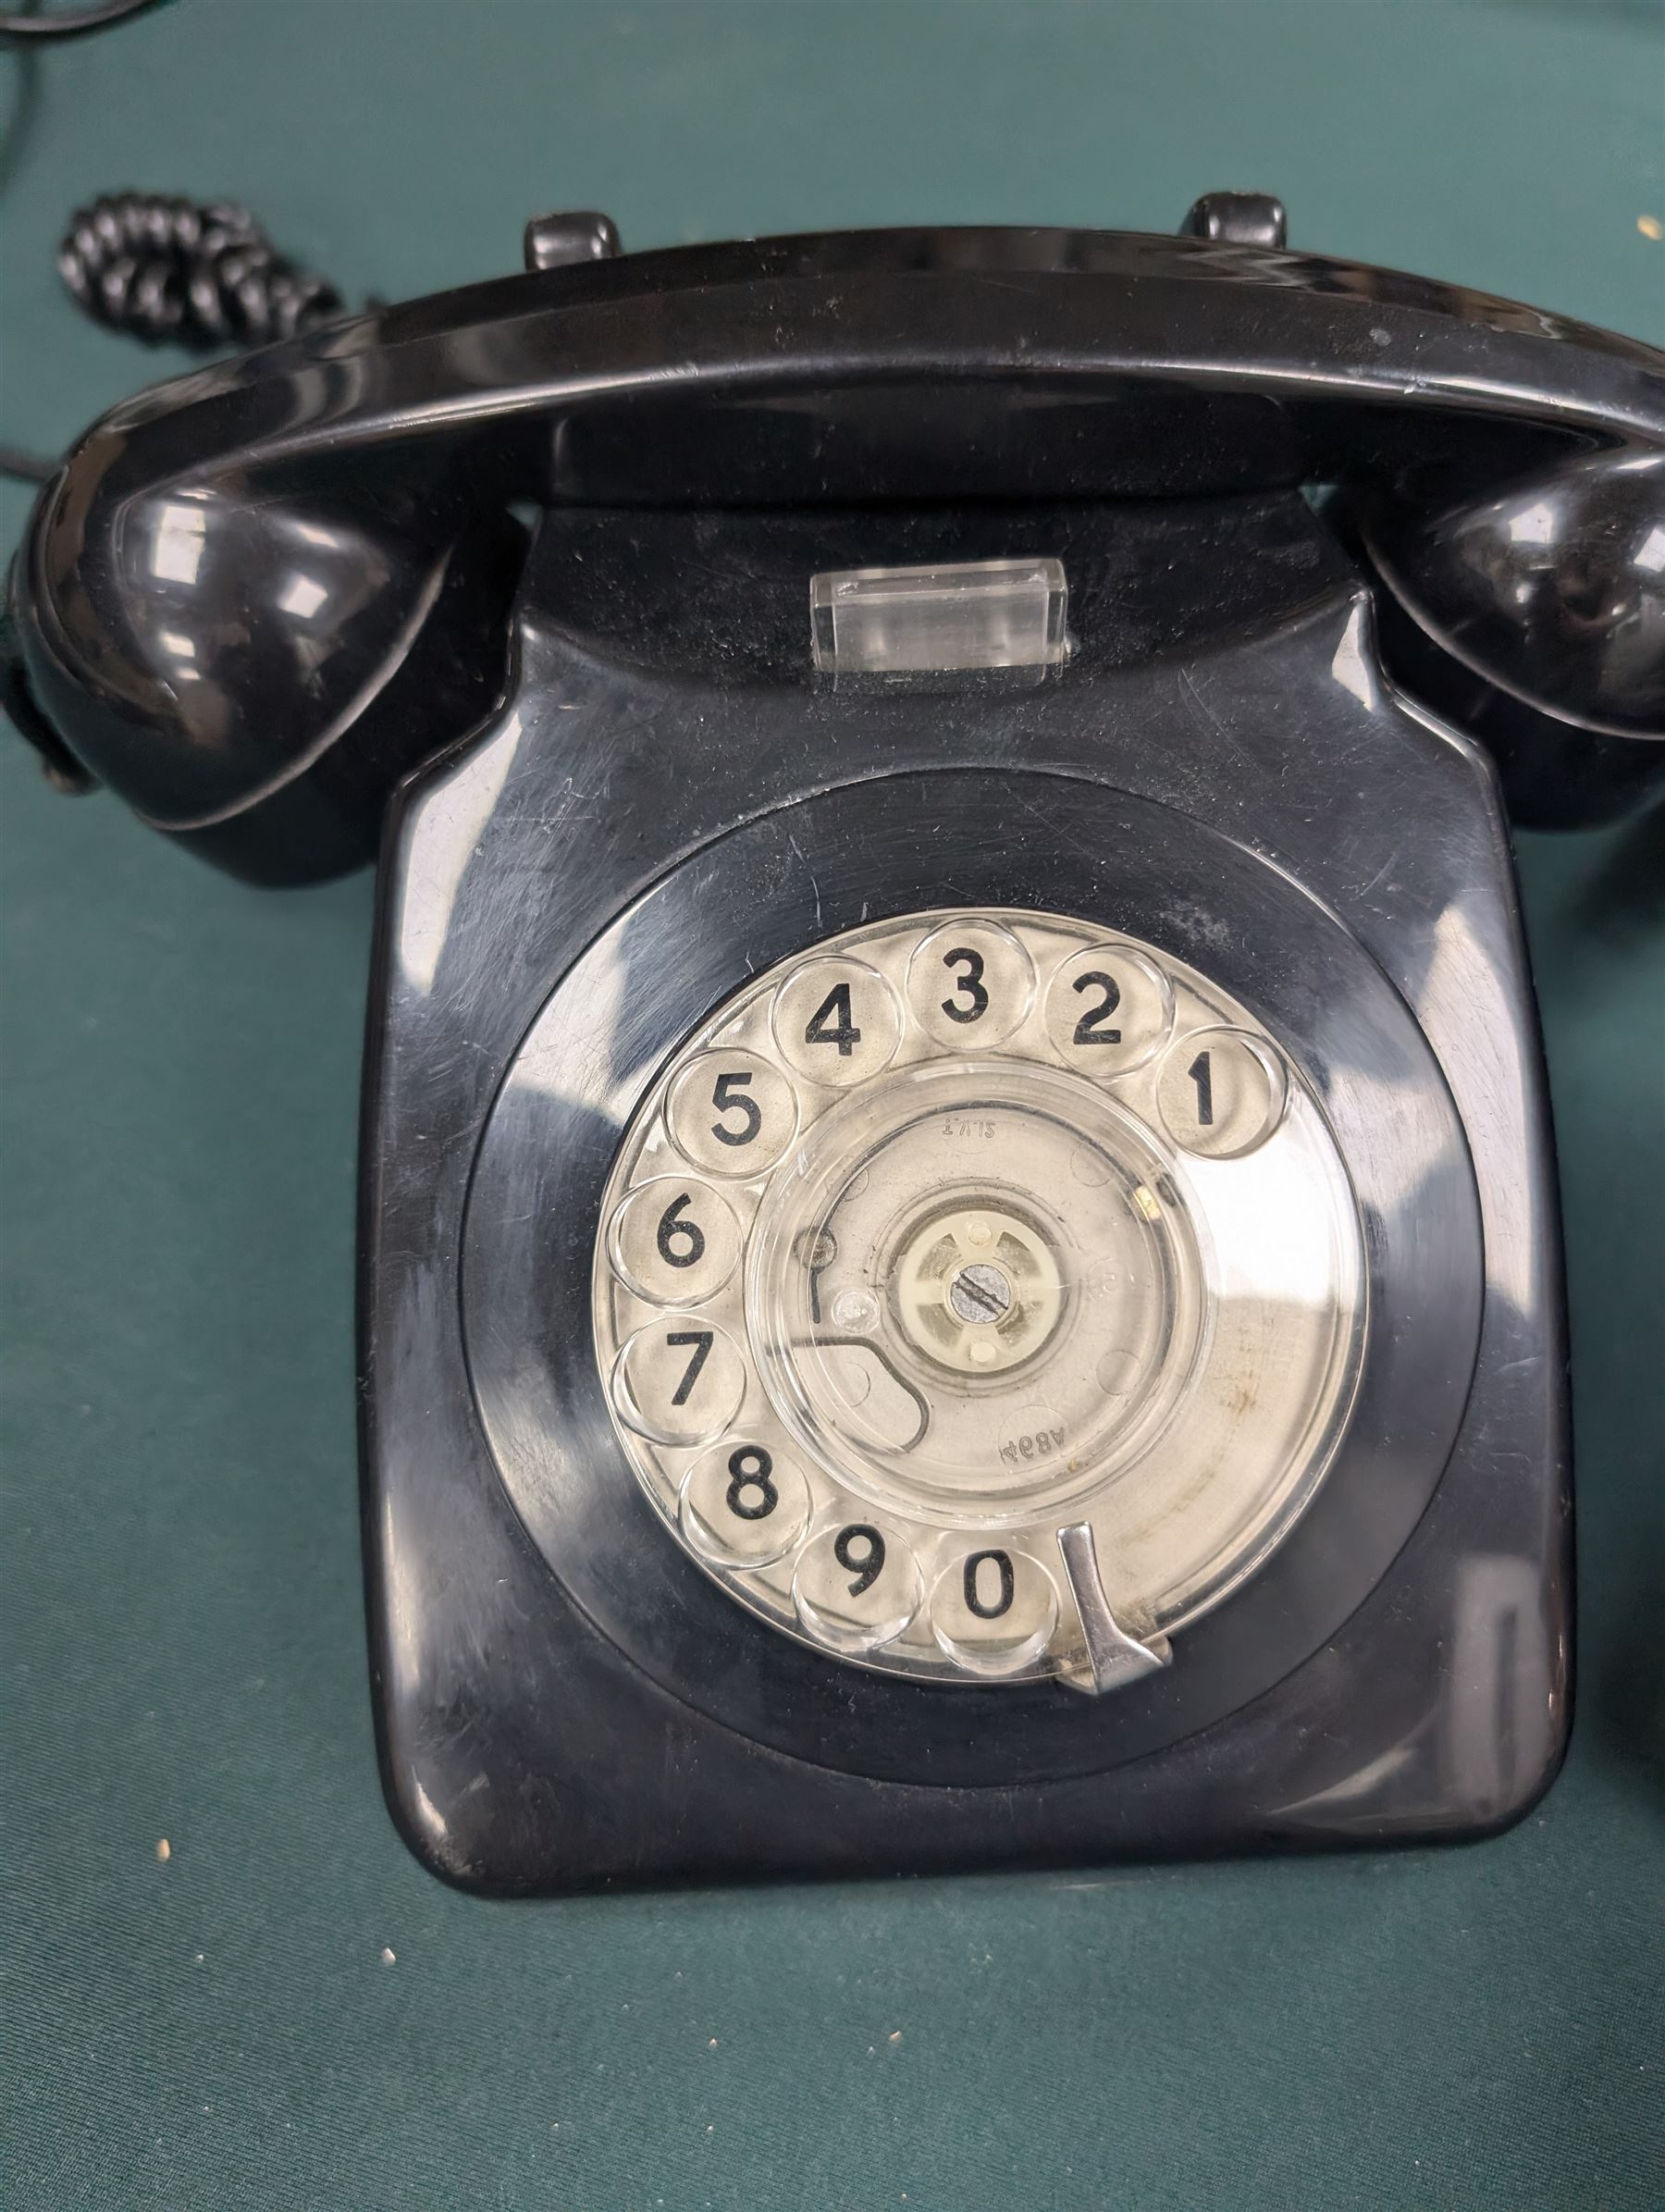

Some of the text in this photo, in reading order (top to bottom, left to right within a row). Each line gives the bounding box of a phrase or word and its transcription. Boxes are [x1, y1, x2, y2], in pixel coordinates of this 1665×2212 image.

[806, 983, 860, 1056] 4
[942, 948, 988, 1023] 3
[1073, 971, 1121, 1044] 2
[711, 1071, 760, 1145] 5
[1189, 1052, 1212, 1124] 1
[658, 1193, 704, 1267] 6
[667, 1332, 712, 1404] 7
[727, 1446, 778, 1520] 8
[834, 1525, 885, 1597] 9
[964, 1550, 1014, 1619] 0
